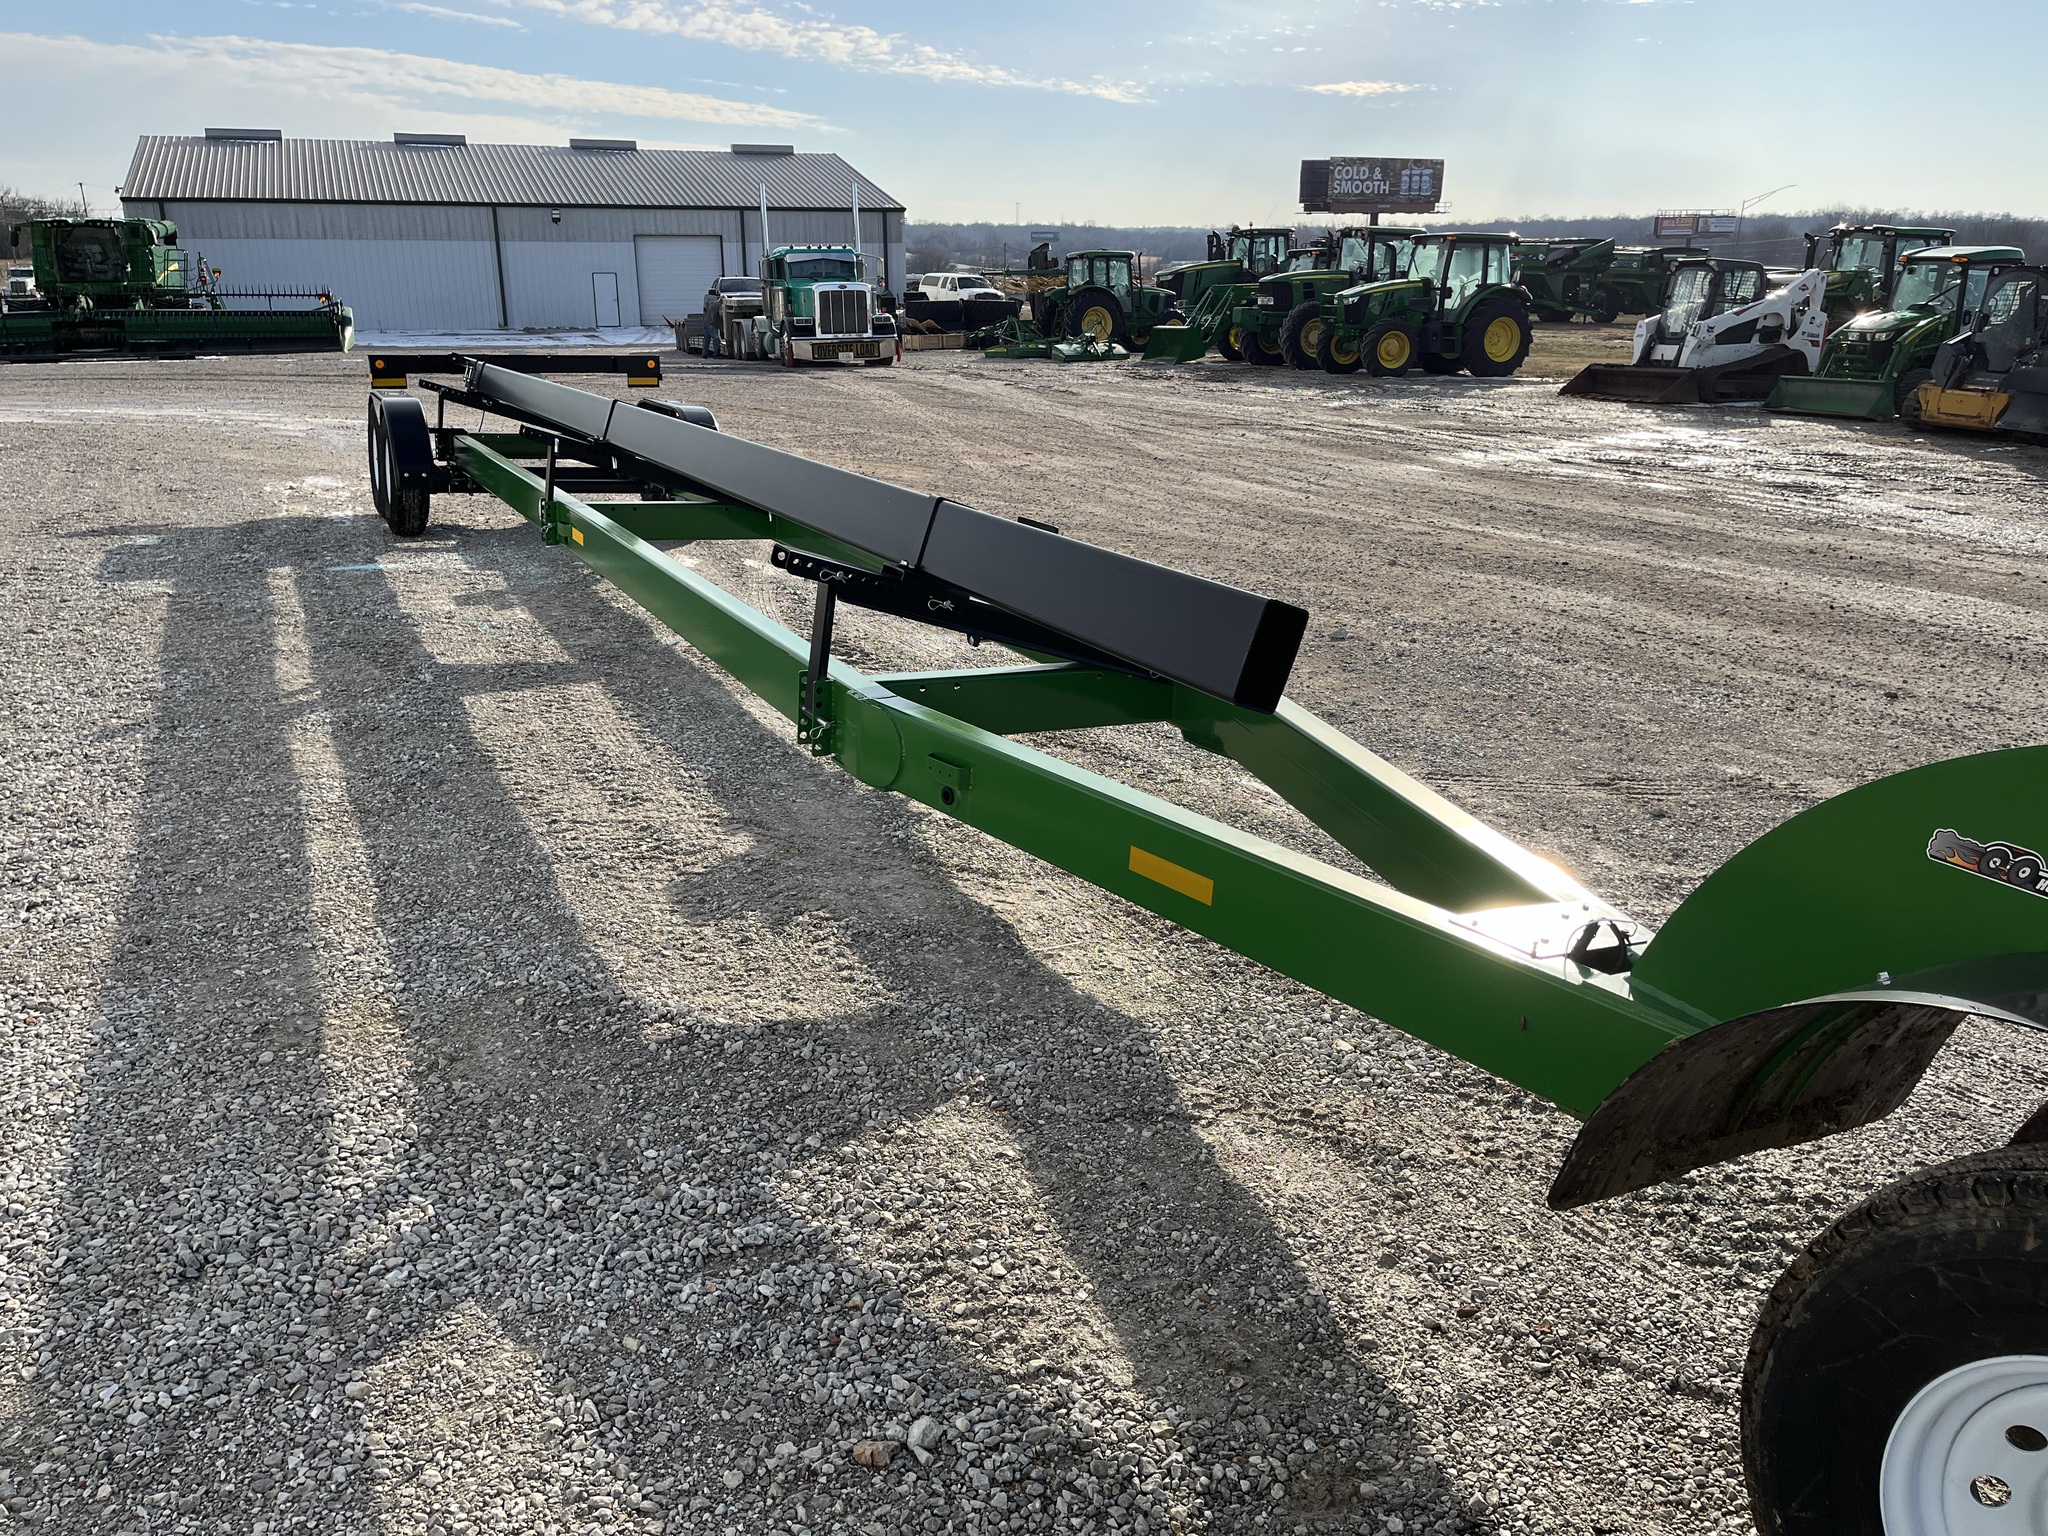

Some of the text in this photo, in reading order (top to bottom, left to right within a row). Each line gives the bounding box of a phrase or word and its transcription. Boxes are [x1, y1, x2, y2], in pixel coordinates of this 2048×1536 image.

[1334, 166, 1382, 180] COLD &
[1333, 180, 1390, 194] SMOOTH
[817, 344, 854, 357] OVERSIZE
[856, 344, 874, 356] LOAD
